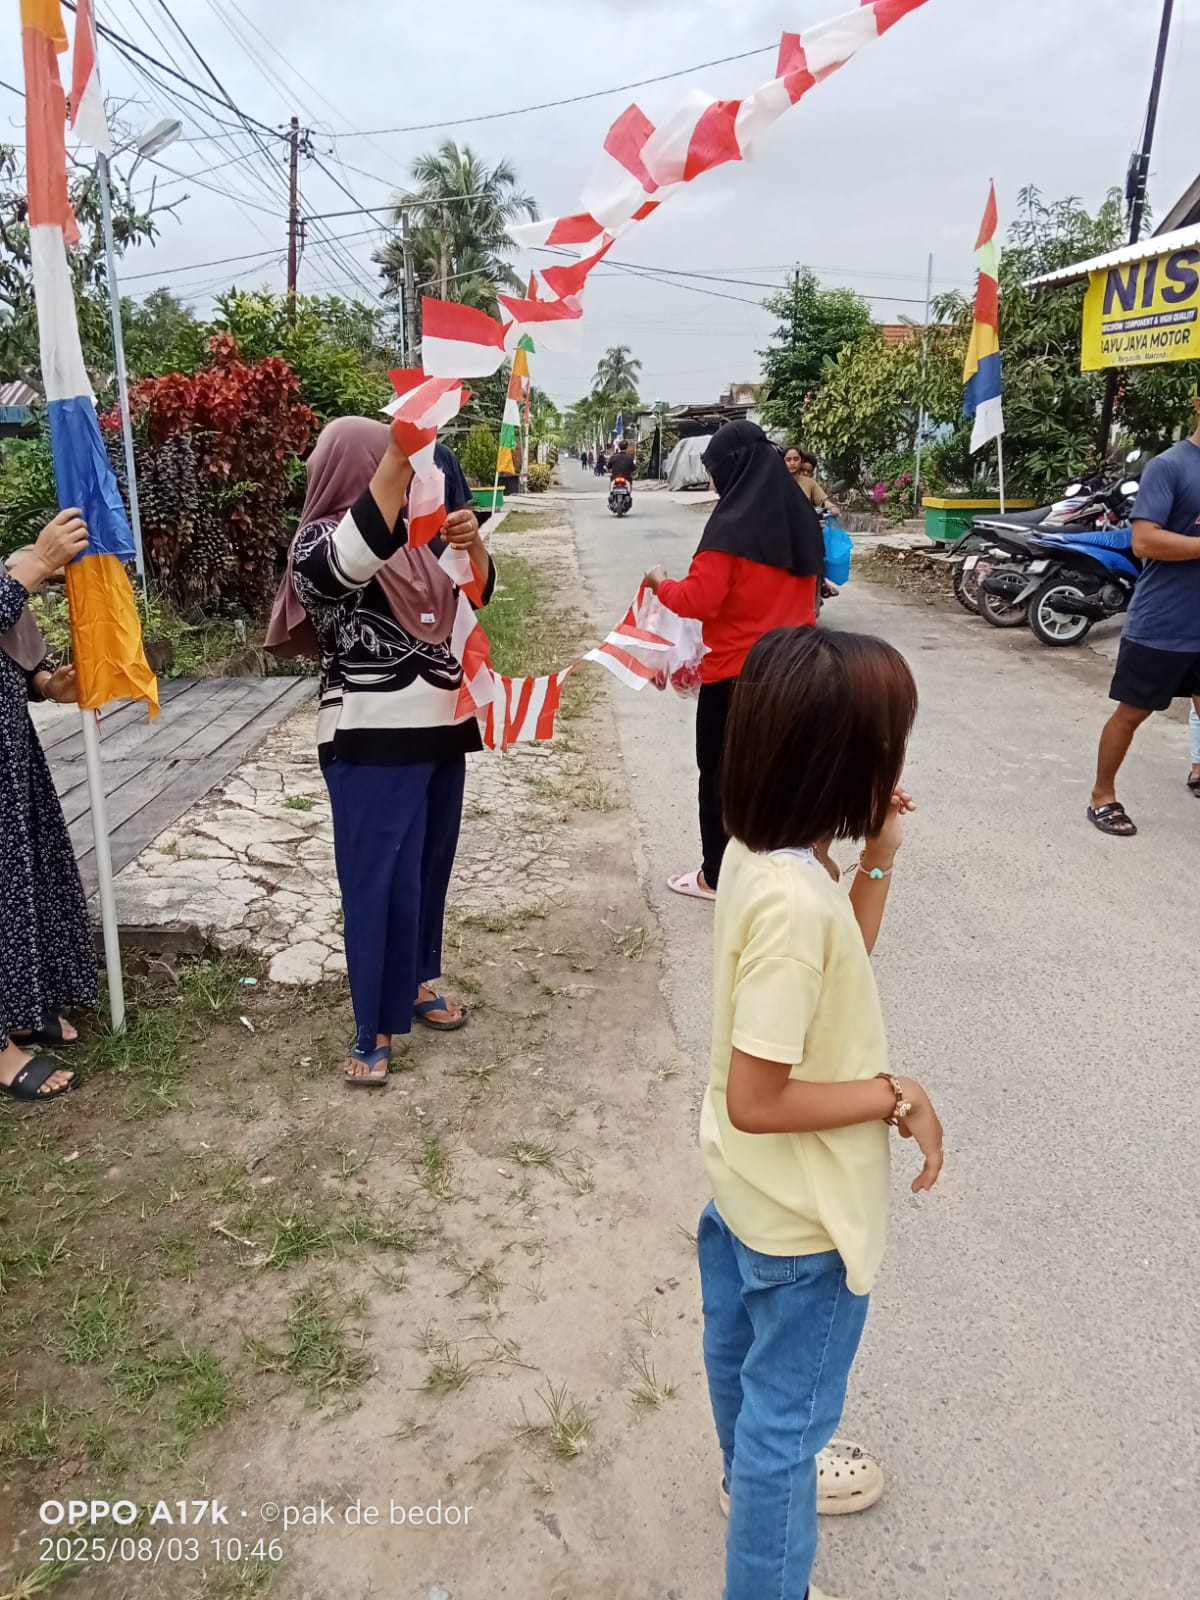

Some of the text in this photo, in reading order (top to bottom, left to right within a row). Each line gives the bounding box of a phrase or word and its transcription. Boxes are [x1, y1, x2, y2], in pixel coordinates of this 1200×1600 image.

[1173, 308, 1196, 322] QUALITY
[1123, 333, 1148, 351] JAYA
[1150, 327, 1191, 349] MOTOR
